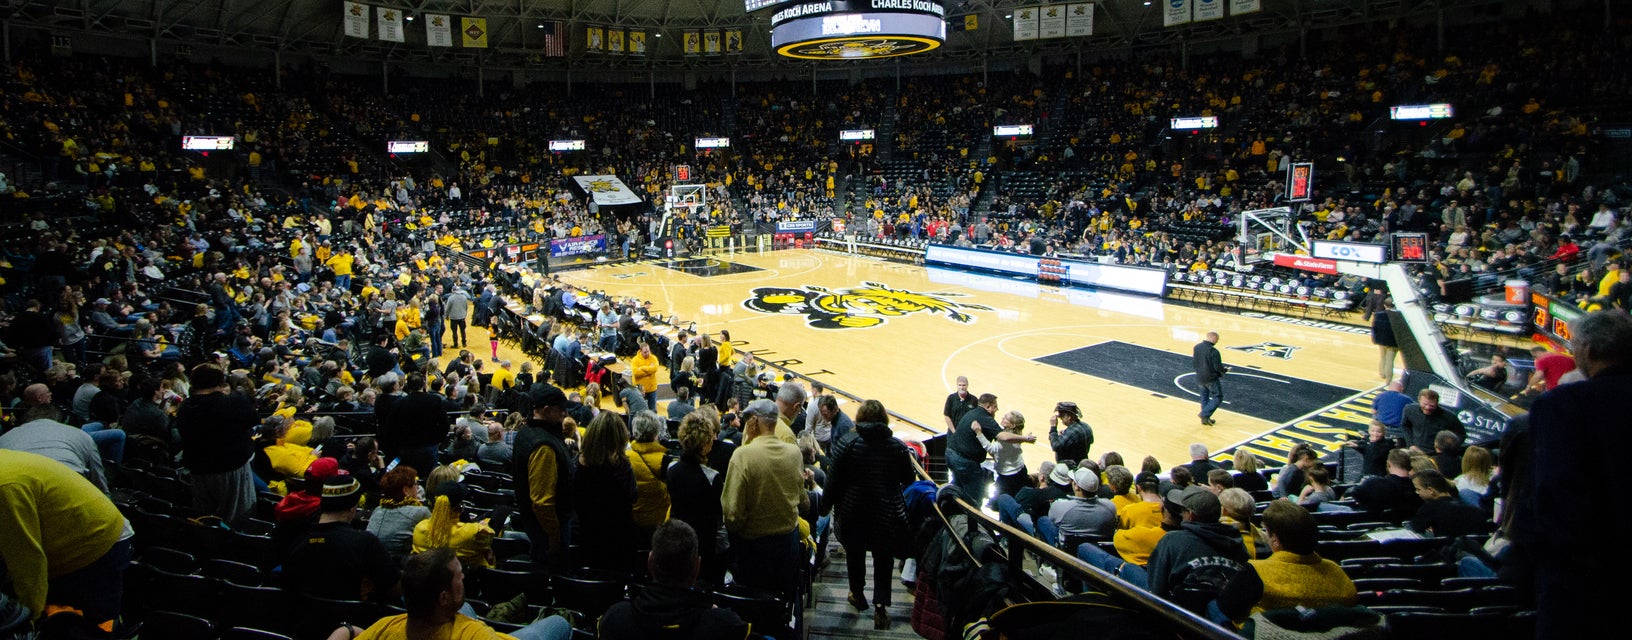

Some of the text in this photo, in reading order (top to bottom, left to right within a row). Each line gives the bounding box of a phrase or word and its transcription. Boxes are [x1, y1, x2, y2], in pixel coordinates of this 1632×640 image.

[784, 6, 801, 19] KOCH
[802, 2, 832, 15] ARENA
[871, 0, 912, 9] CHARLES
[913, 0, 931, 12] KOCH
[1475, 415, 1506, 432] STA
[1188, 555, 1246, 572] ELITE
